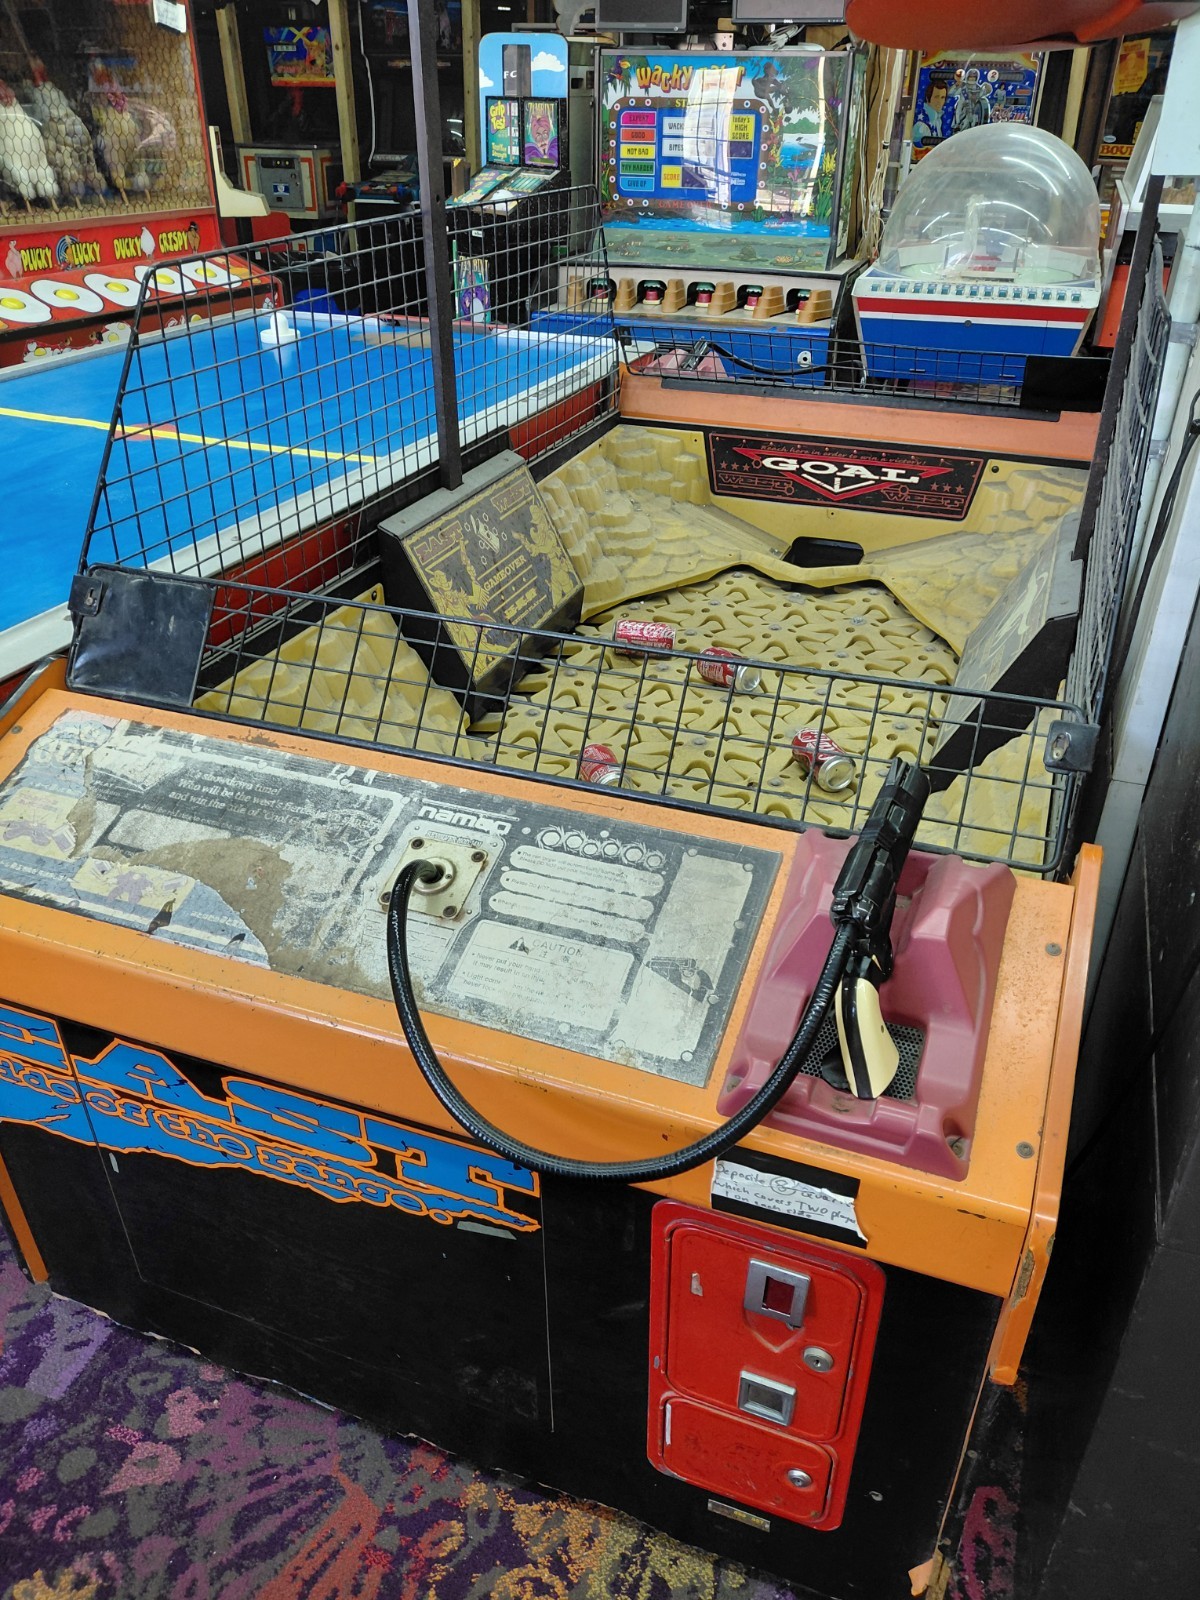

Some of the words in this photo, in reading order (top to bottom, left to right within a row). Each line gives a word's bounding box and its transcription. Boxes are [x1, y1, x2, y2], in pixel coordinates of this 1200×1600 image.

[489, 100, 506, 118] Grip
[668, 122, 685, 131] WACK
[630, 131, 646, 139] GOOD
[731, 132, 750, 140] SCORE
[626, 147, 638, 155] NOT
[638, 148, 649, 156] BAD
[668, 143, 684, 152] BITES
[621, 163, 633, 172] TRY
[632, 164, 654, 172] HARDER
[627, 179, 640, 188] GIVE
[663, 173, 680, 181] SCORE
[658, 201, 682, 209] GAME
[113, 237, 142, 260] DUCKY
[158, 230, 190, 254] CRISPY
[20, 247, 52, 272] PLUCKY
[71, 241, 100, 265] LUCKY
[760, 444, 787, 452] Reach
[762, 457, 919, 484] GOAL
[200, 771, 252, 790] showdown
[178, 778, 201, 791] Who
[201, 783, 220, 795] will
[220, 787, 234, 798] be
[234, 791, 251, 802] the
[252, 794, 282, 809] west's
[168, 790, 188, 801] and
[188, 794, 207, 806] win
[207, 798, 226, 809] the
[248, 806, 260, 817] of
[531, 938, 584, 958] CAUTION
[475, 952, 495, 962] Never
[495, 957, 507, 966] put
[507, 960, 523, 969] your
[523, 964, 541, 973] hand
[478, 962, 492, 970] may
[493, 965, 512, 974] result
[463, 979, 481, 988] never
[466, 971, 483, 982] Light
[85, 1091, 150, 1127] of
[154, 1109, 252, 1160] the
[257, 1142, 454, 1224] range.
[714, 1179, 750, 1196] which
[753, 1191, 792, 1207] covers
[794, 1200, 829, 1214] TWO
